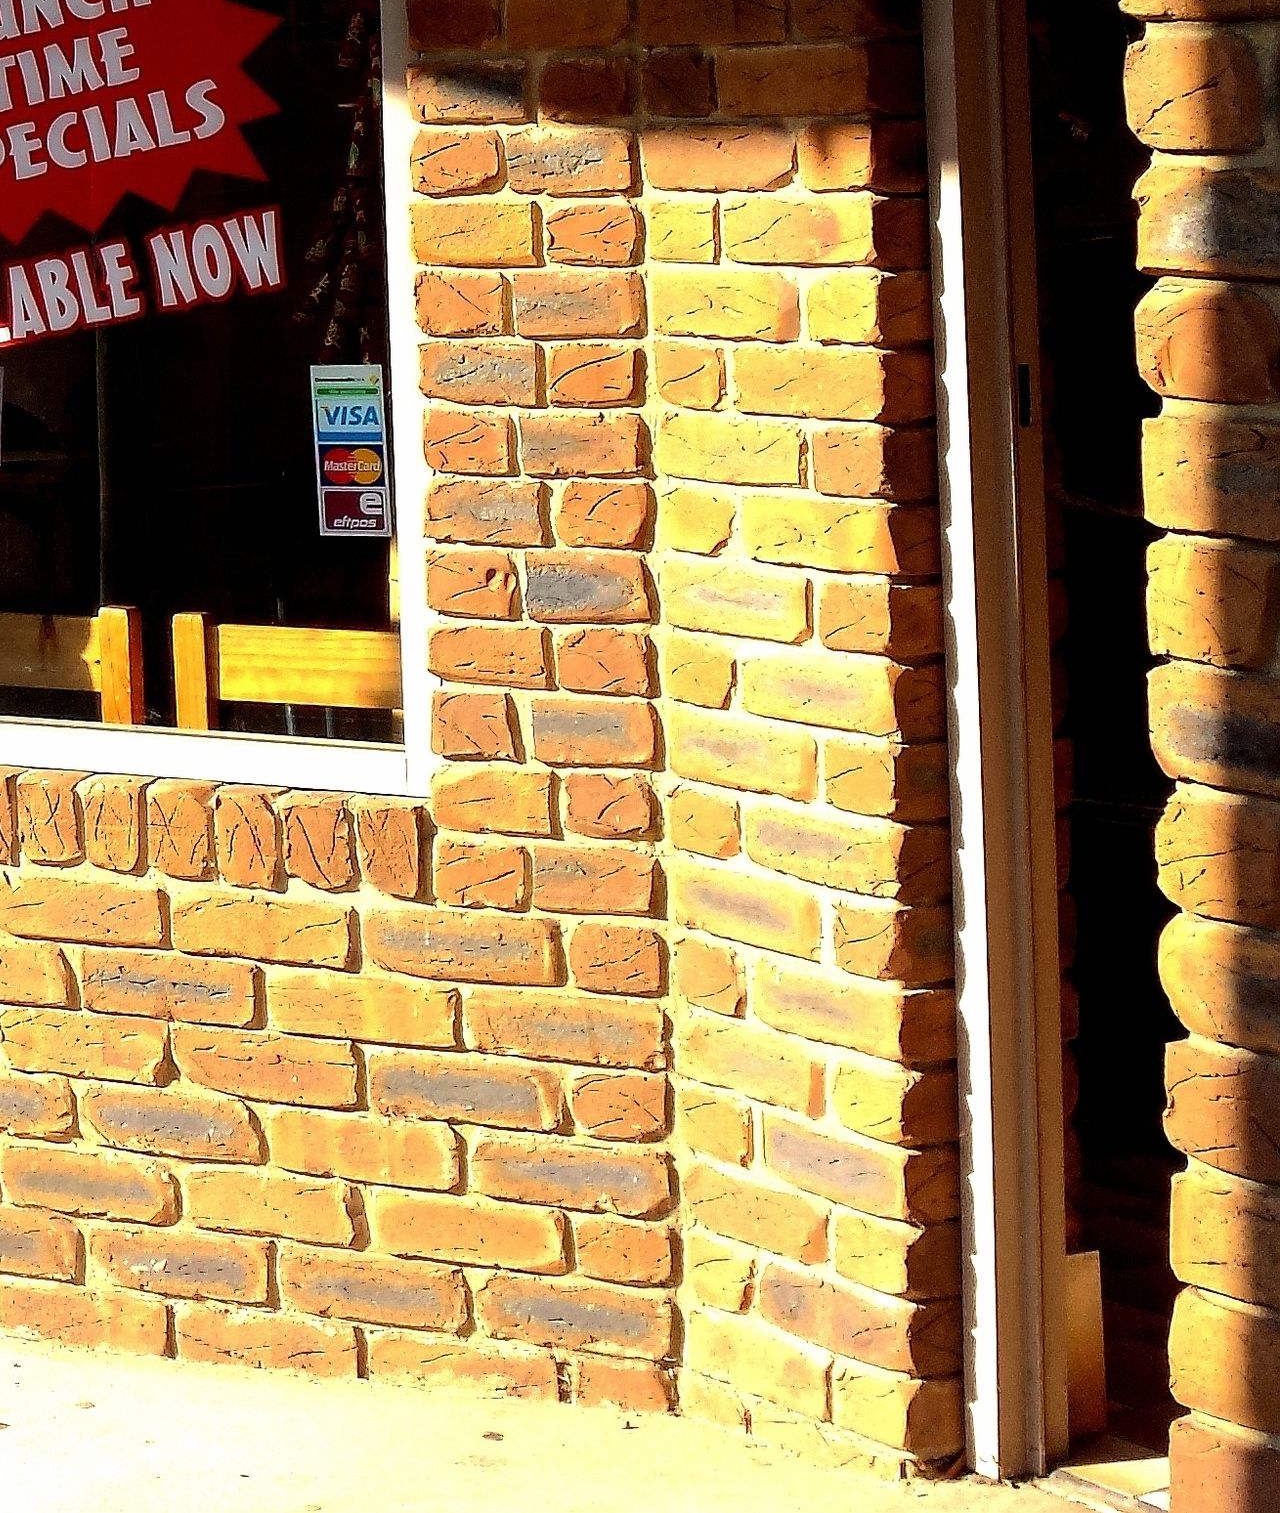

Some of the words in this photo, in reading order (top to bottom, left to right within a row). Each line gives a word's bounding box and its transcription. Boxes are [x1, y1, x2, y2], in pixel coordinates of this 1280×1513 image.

[149, 211, 281, 307] NOW
[321, 405, 380, 425] VISA
[324, 460, 381, 472] MasterCard
[333, 515, 377, 529] eftpos
